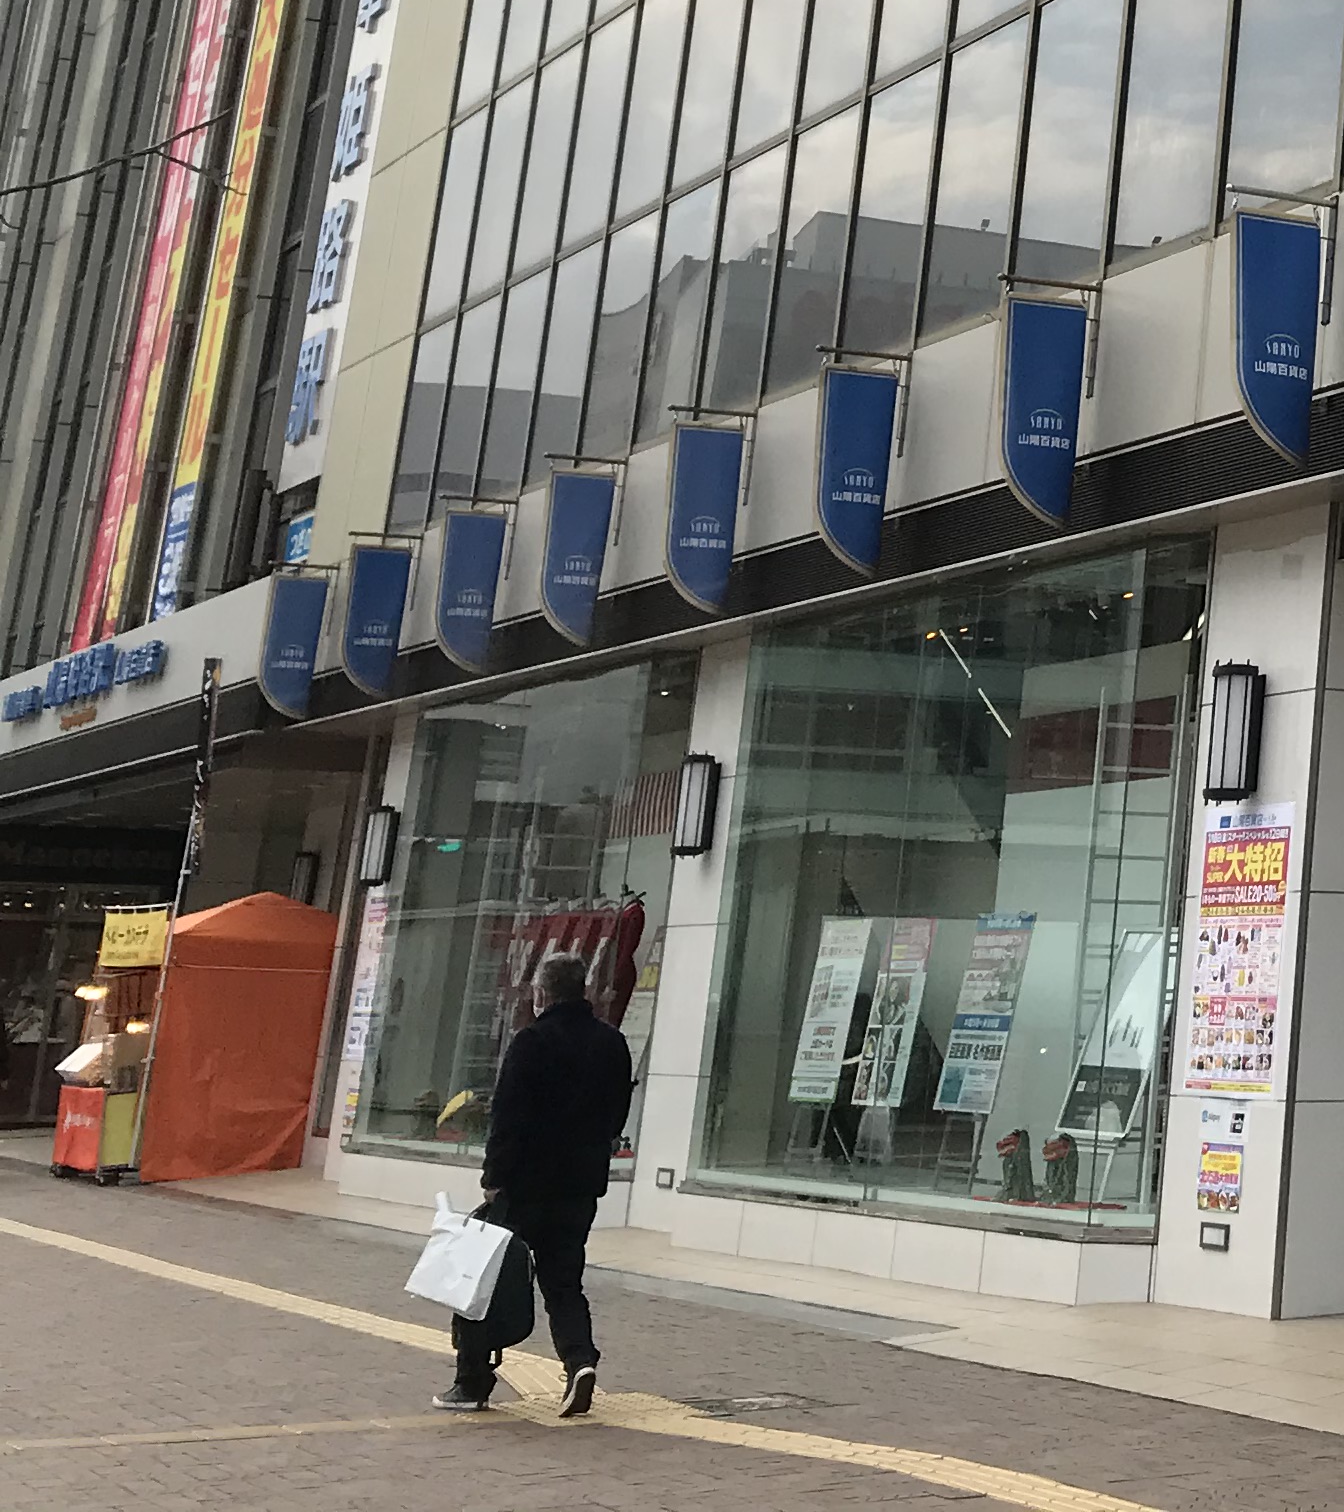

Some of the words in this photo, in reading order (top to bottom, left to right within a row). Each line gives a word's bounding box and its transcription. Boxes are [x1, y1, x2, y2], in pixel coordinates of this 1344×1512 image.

[1266, 341, 1299, 359] SANYO
[1254, 358, 1308, 380] 山陽百貨店
[1030, 412, 1063, 430] SANYO
[1018, 433, 1070, 450] 山陽百貨店
[832, 490, 881, 505] 山陽百貨店
[1225, 842, 1285, 882] 大特招
